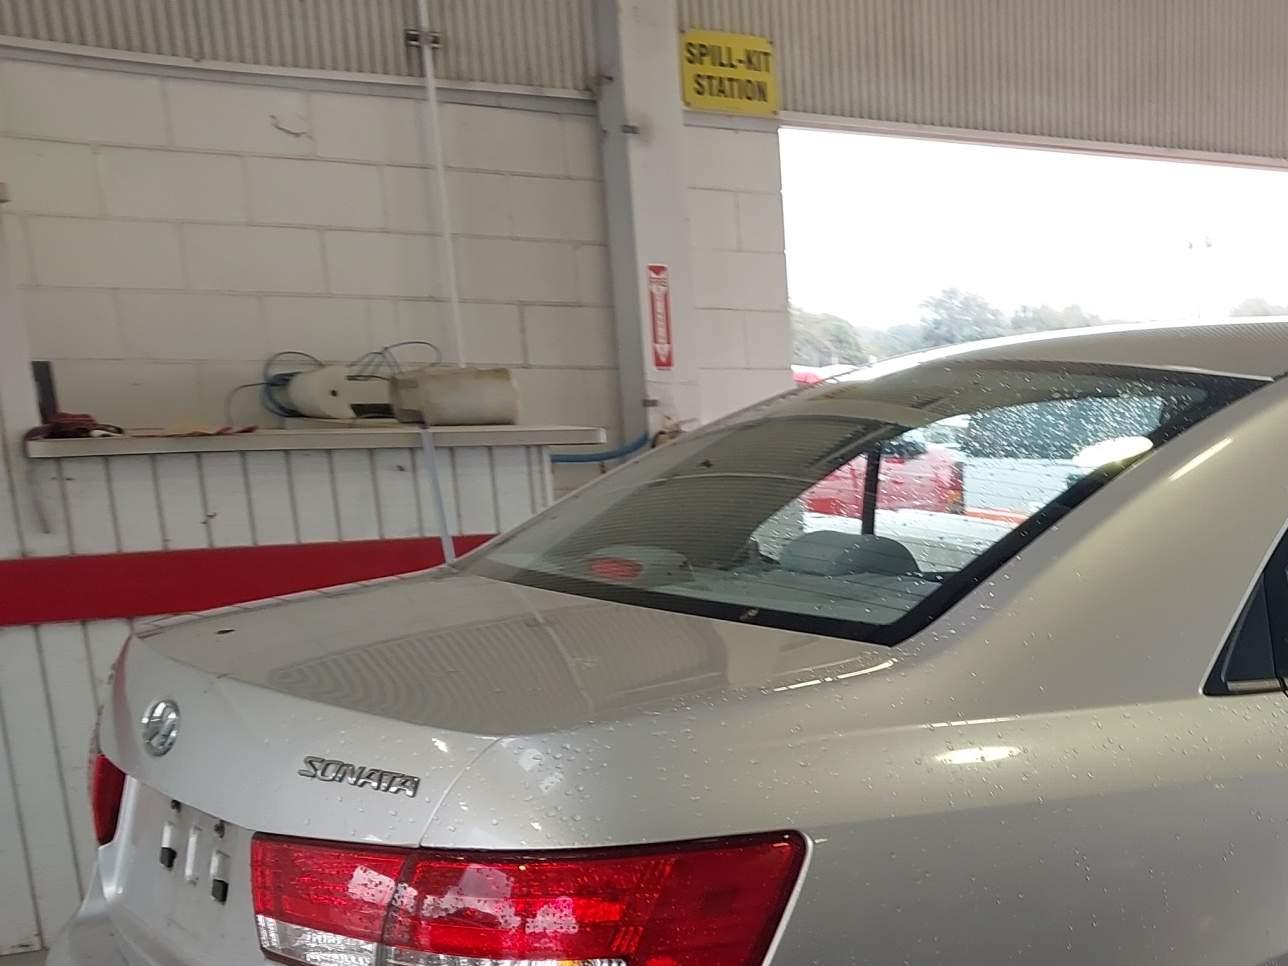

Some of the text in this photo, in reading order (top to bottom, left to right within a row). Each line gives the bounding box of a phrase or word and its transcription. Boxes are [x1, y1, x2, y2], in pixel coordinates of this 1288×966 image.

[685, 42, 772, 72] SPILL-KIT
[694, 74, 768, 102] STATION
[298, 755, 420, 798] SONATA
